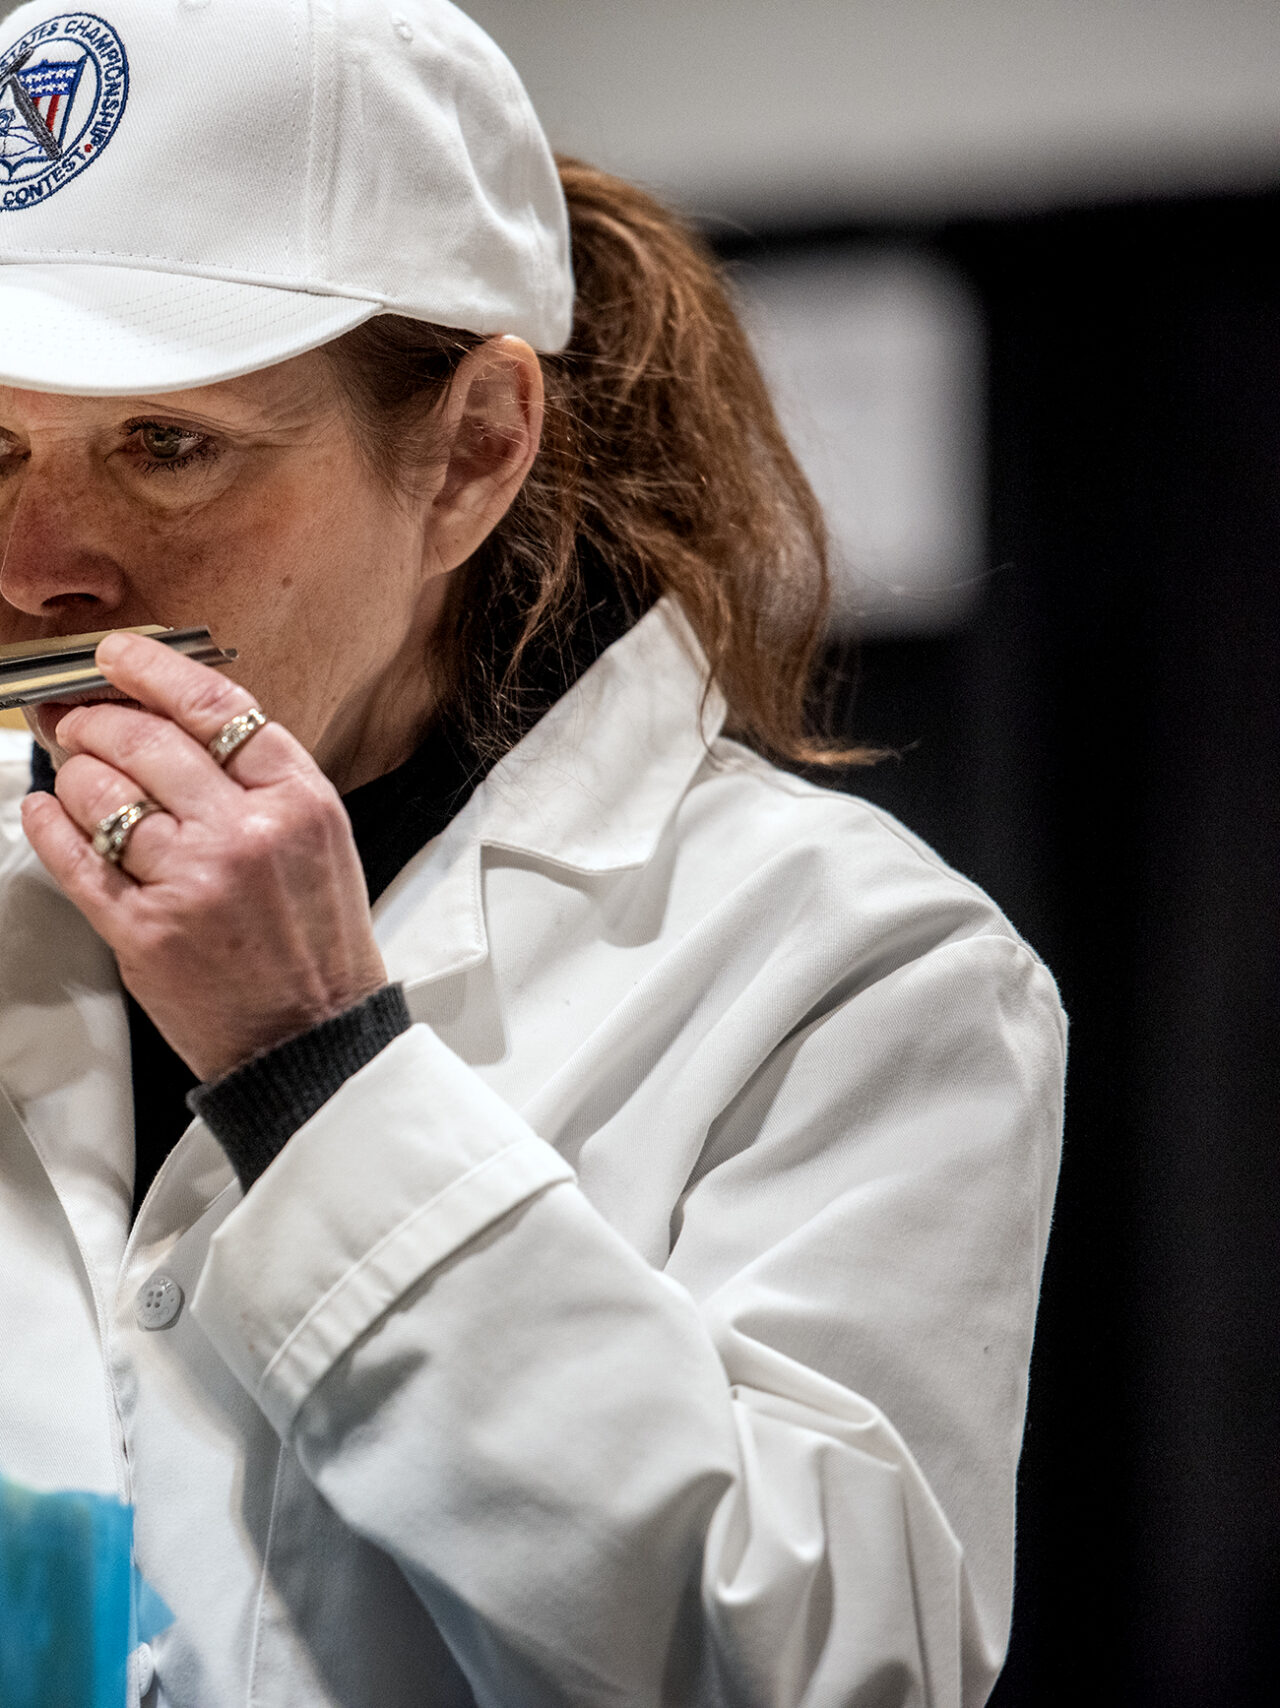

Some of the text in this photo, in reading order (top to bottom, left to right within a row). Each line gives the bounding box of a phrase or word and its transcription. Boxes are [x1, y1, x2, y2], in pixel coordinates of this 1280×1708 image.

[0, 22, 59, 73] STATES
[64, 19, 122, 148] CHAMPIONSHIP
[3, 148, 87, 208] CONTEST
